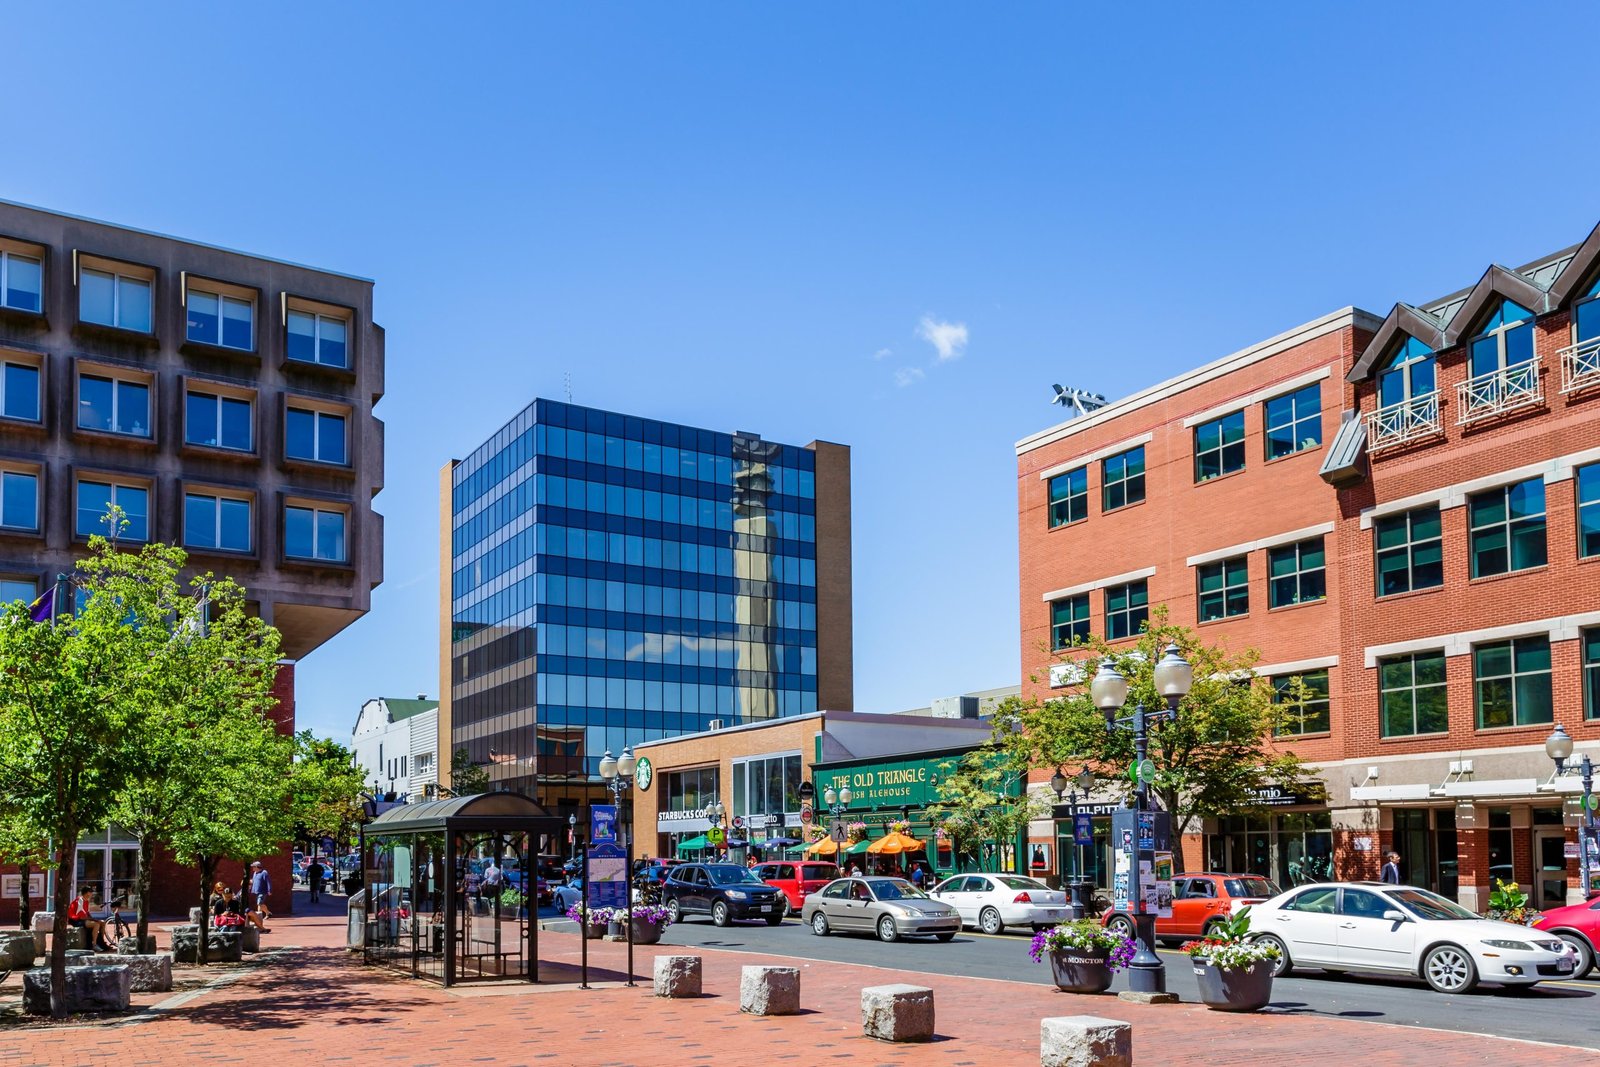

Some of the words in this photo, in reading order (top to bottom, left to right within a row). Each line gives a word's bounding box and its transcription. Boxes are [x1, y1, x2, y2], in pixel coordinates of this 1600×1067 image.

[832, 775, 850, 788] THE
[854, 773, 873, 787] OLD
[877, 768, 926, 785] TRIANGLE
[869, 787, 911, 798] ALEHOUSE
[1259, 787, 1281, 798] mio
[658, 810, 694, 821] STARBUCKS
[695, 809, 709, 818] COF
[1069, 805, 1119, 815] OLPITT
[713, 830, 720, 838] P
